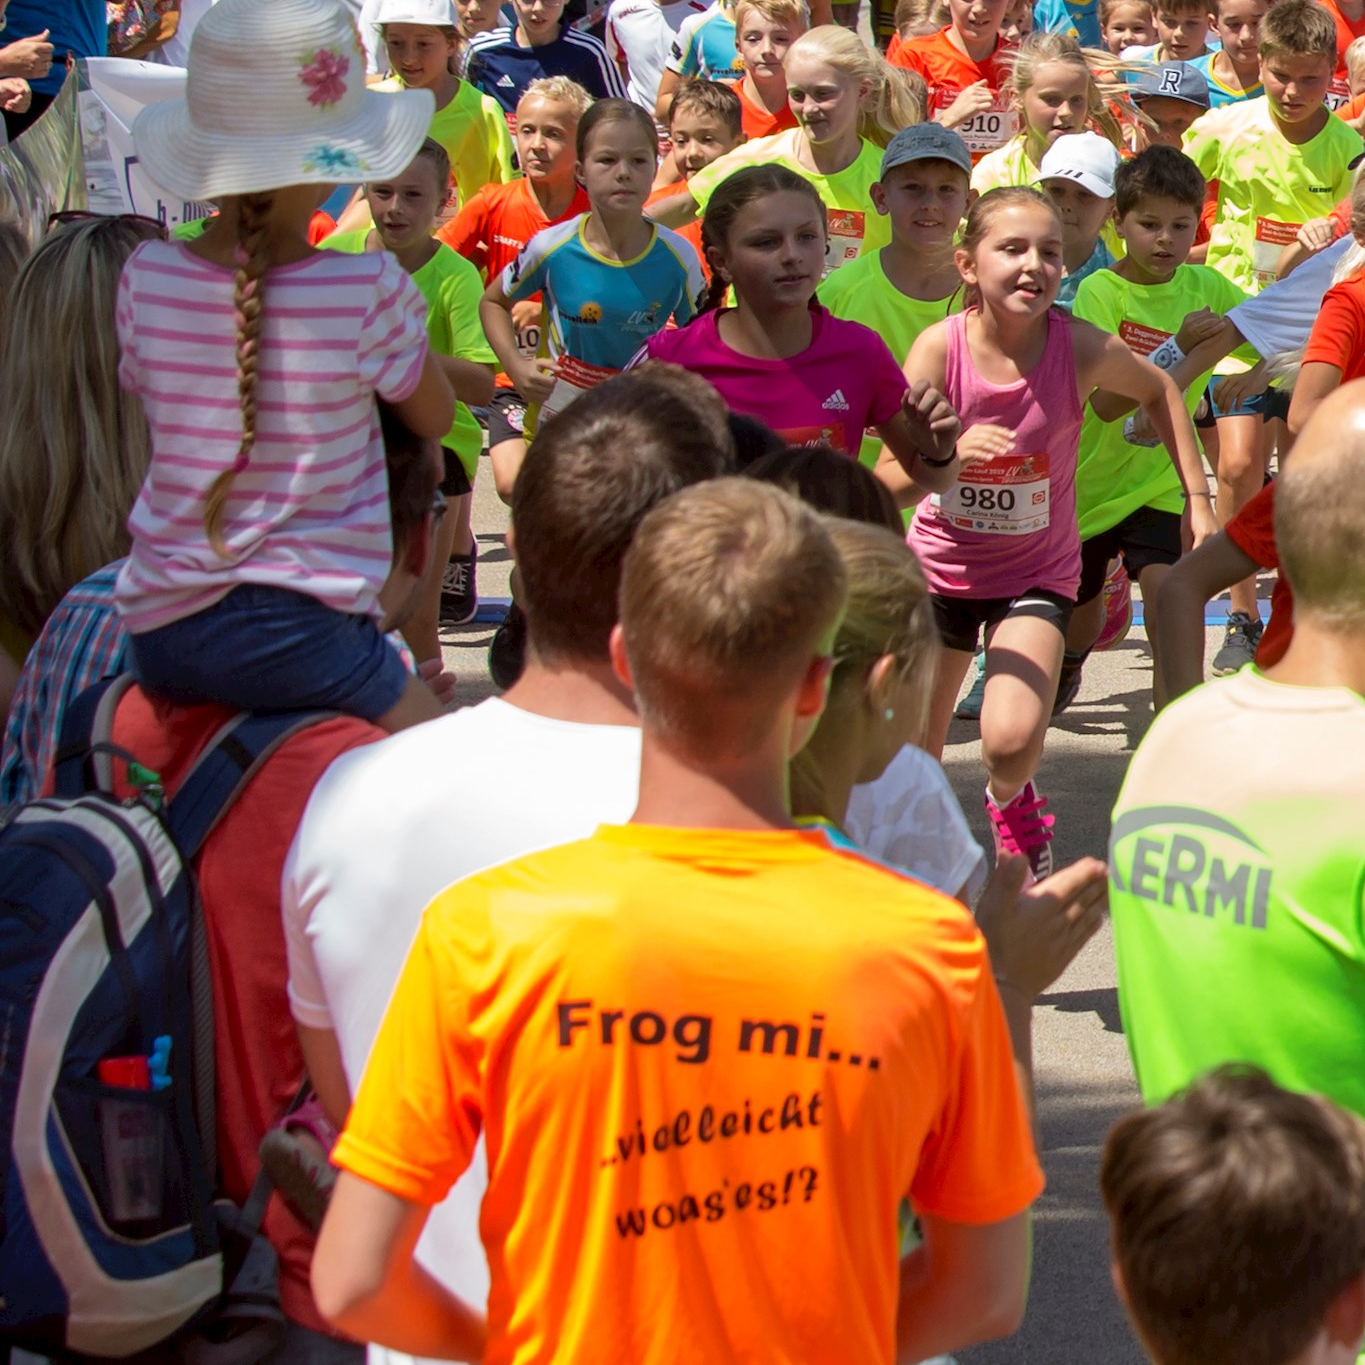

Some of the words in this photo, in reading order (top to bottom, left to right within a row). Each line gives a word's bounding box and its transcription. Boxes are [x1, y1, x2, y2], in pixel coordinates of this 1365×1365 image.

[1160, 68, 1181, 95] R
[961, 115, 1001, 133] 910
[822, 401, 850, 410] adidas
[960, 486, 1015, 511] 980
[556, 999, 713, 1064] Frog
[737, 1011, 882, 1071] mi...
